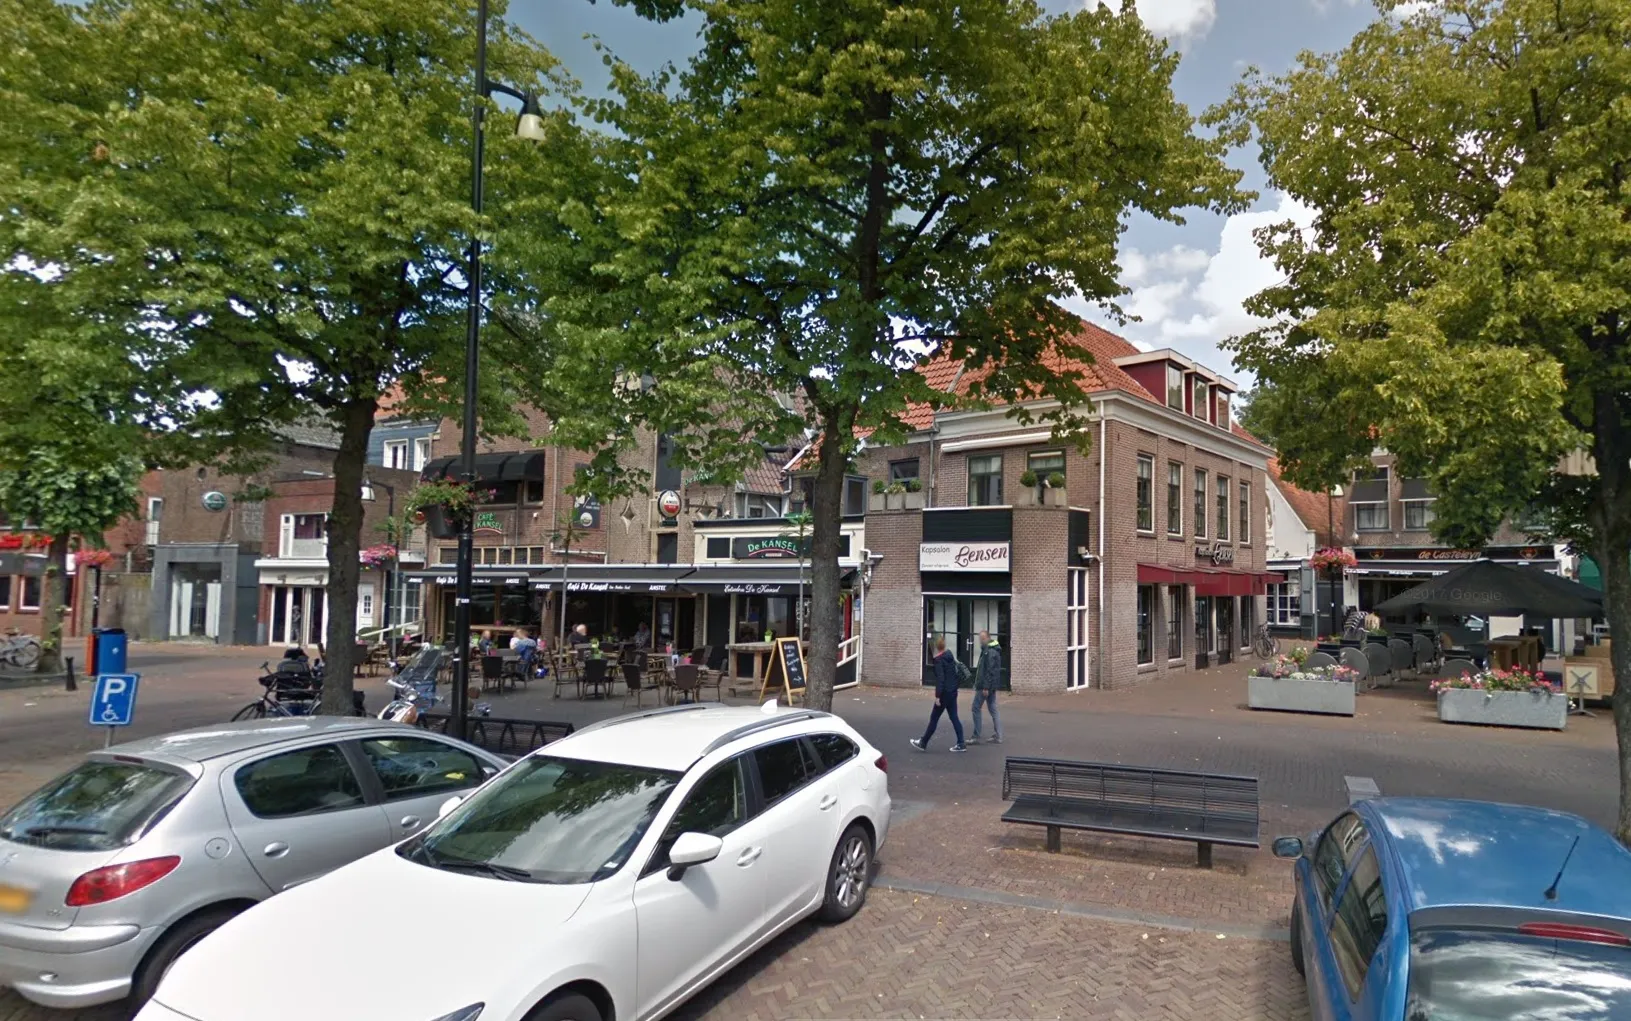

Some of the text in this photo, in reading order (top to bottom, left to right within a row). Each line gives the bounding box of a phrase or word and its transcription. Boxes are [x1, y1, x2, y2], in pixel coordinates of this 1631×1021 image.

[477, 520, 503, 531] KANSEL
[747, 540, 798, 553] De KANSEL
[921, 545, 950, 555] Kapsalon
[1418, 550, 1431, 559] de
[756, 584, 781, 594] Kansel
[102, 678, 126, 703] P
